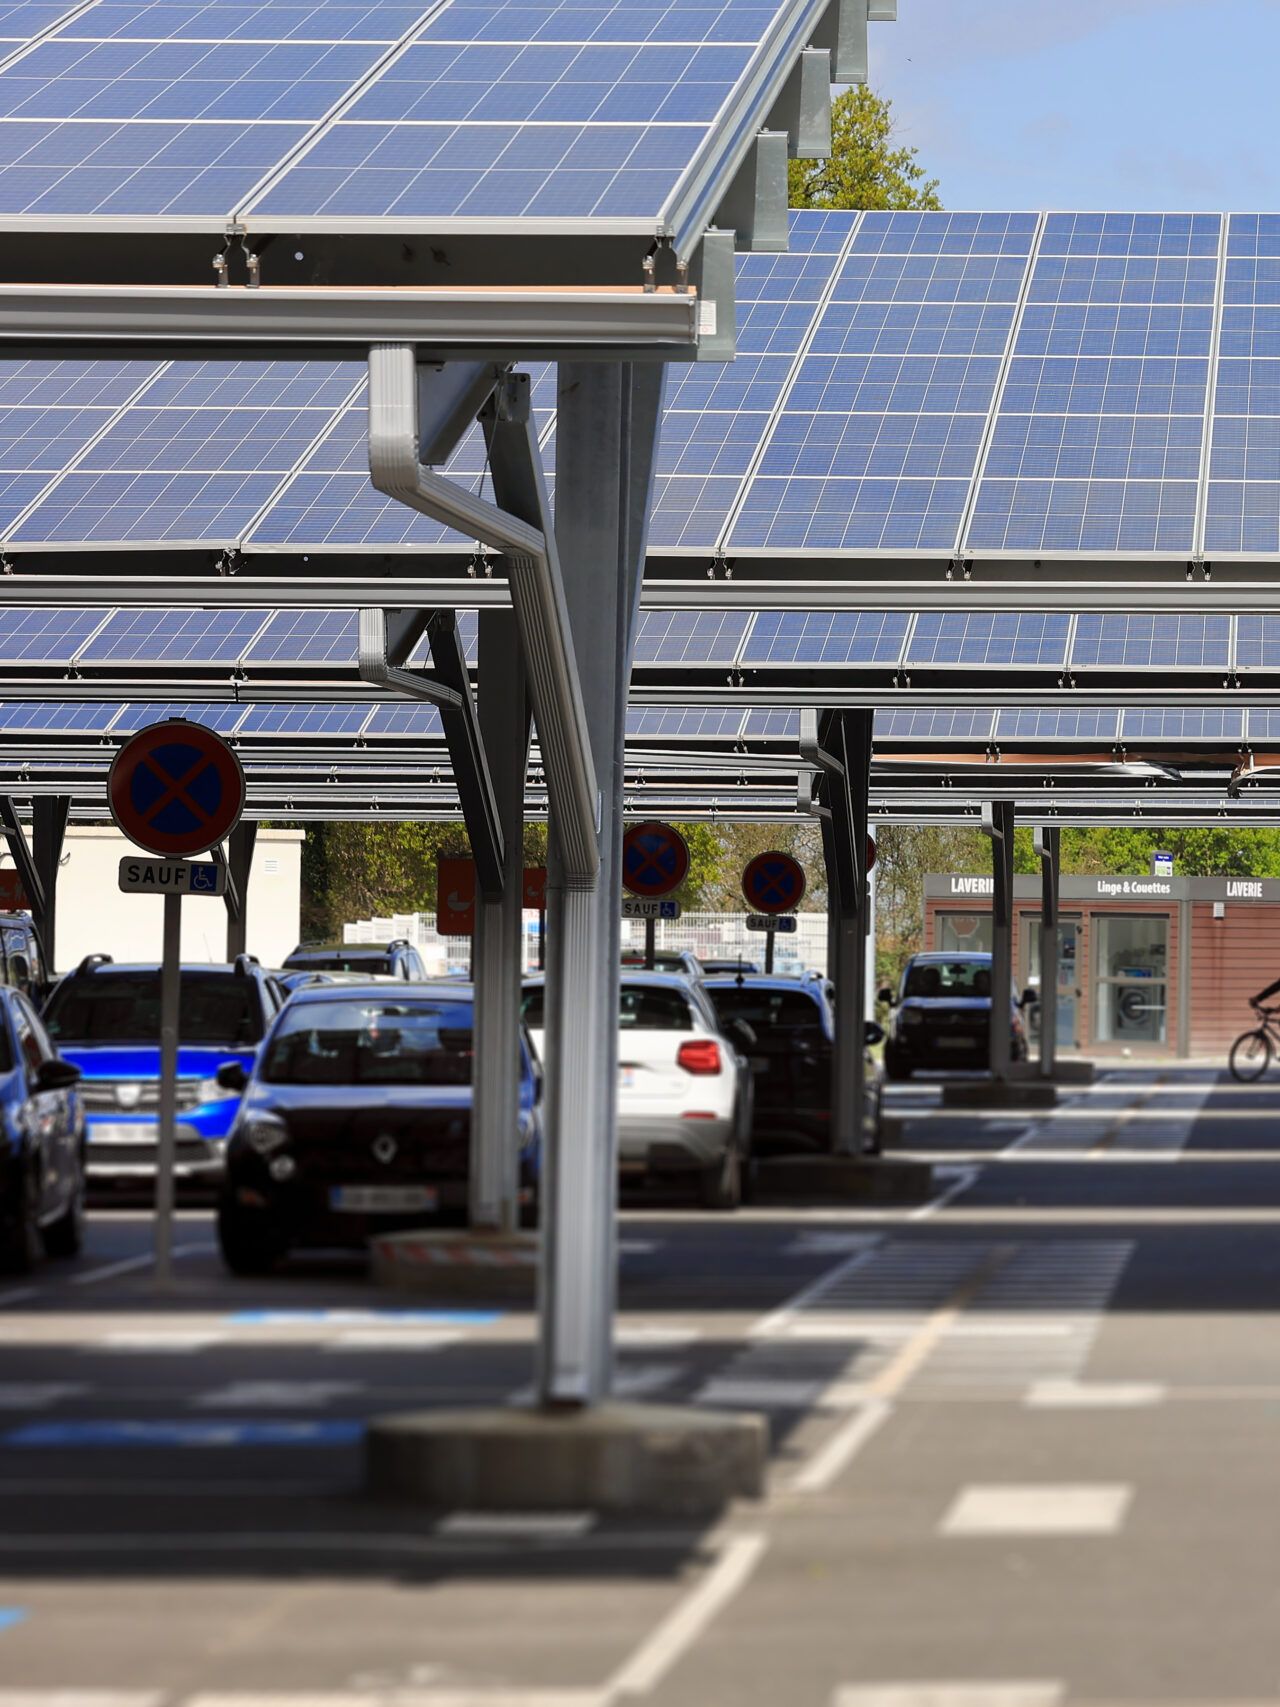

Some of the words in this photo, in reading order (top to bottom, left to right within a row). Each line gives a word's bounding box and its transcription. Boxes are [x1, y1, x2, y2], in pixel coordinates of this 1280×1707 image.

[127, 864, 187, 886] SAUF
[1097, 880, 1122, 896] Linge
[1123, 881, 1131, 893] &
[1131, 881, 1171, 894] Couettes
[1226, 881, 1263, 897] LAVERIE
[624, 903, 659, 915] SAUF
[750, 918, 778, 929] SAUF
